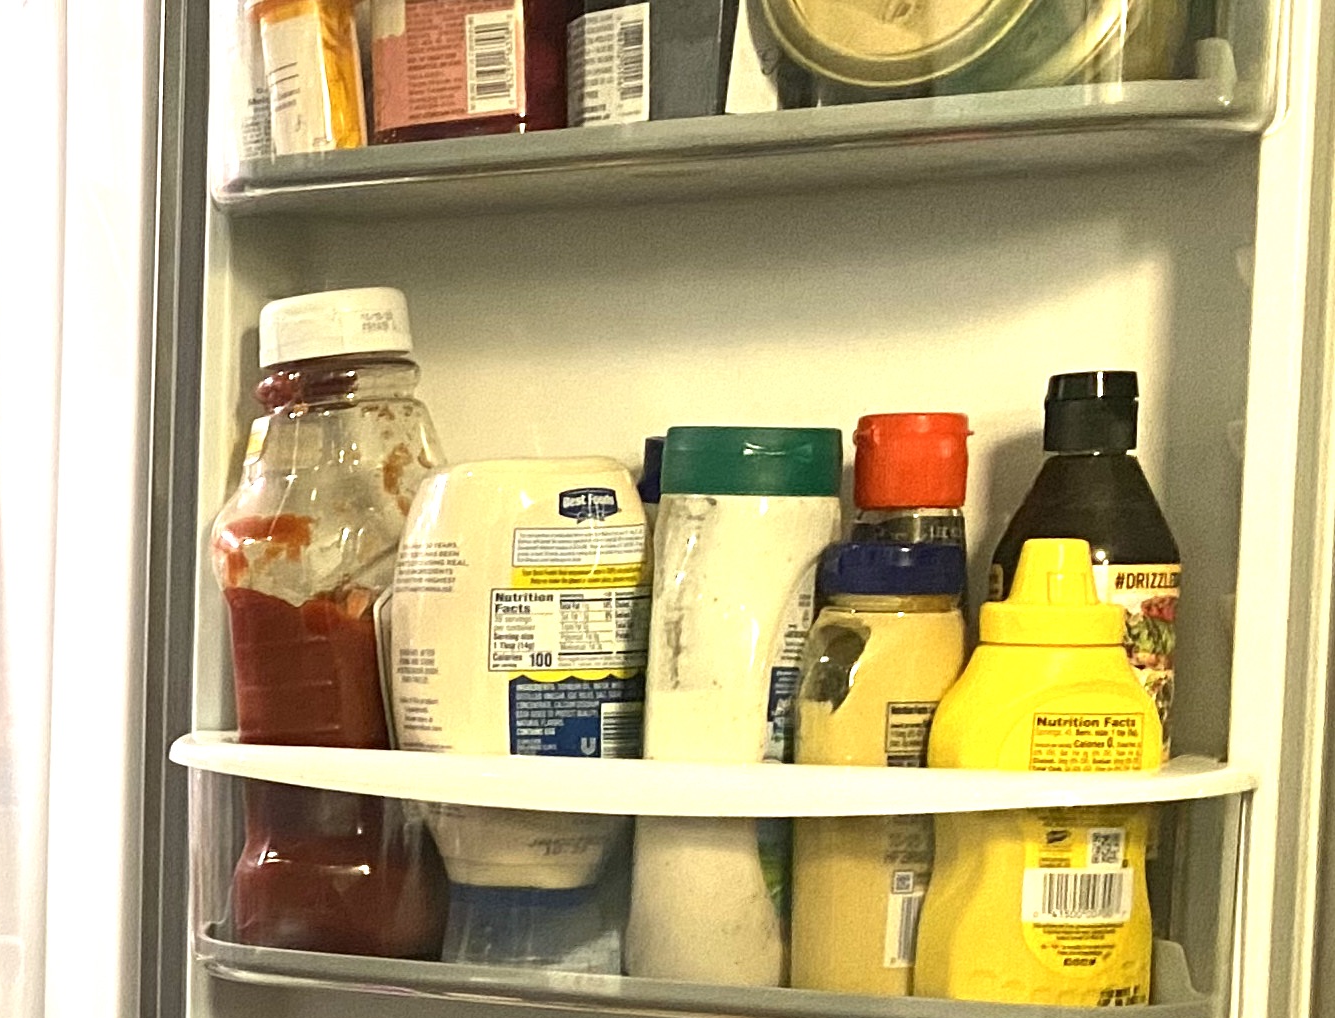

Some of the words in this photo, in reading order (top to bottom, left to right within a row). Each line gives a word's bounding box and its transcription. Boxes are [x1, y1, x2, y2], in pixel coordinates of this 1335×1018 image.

[563, 496, 586, 508] Best
[588, 494, 615, 506] Foods
[495, 593, 554, 602] Nutrition
[494, 604, 531, 614] Facts
[493, 654, 522, 662] Calories
[530, 653, 552, 667] 100
[1037, 717, 1099, 727] Nutrition
[1104, 717, 1136, 727] Facts
[1074, 740, 1104, 748] Calories
